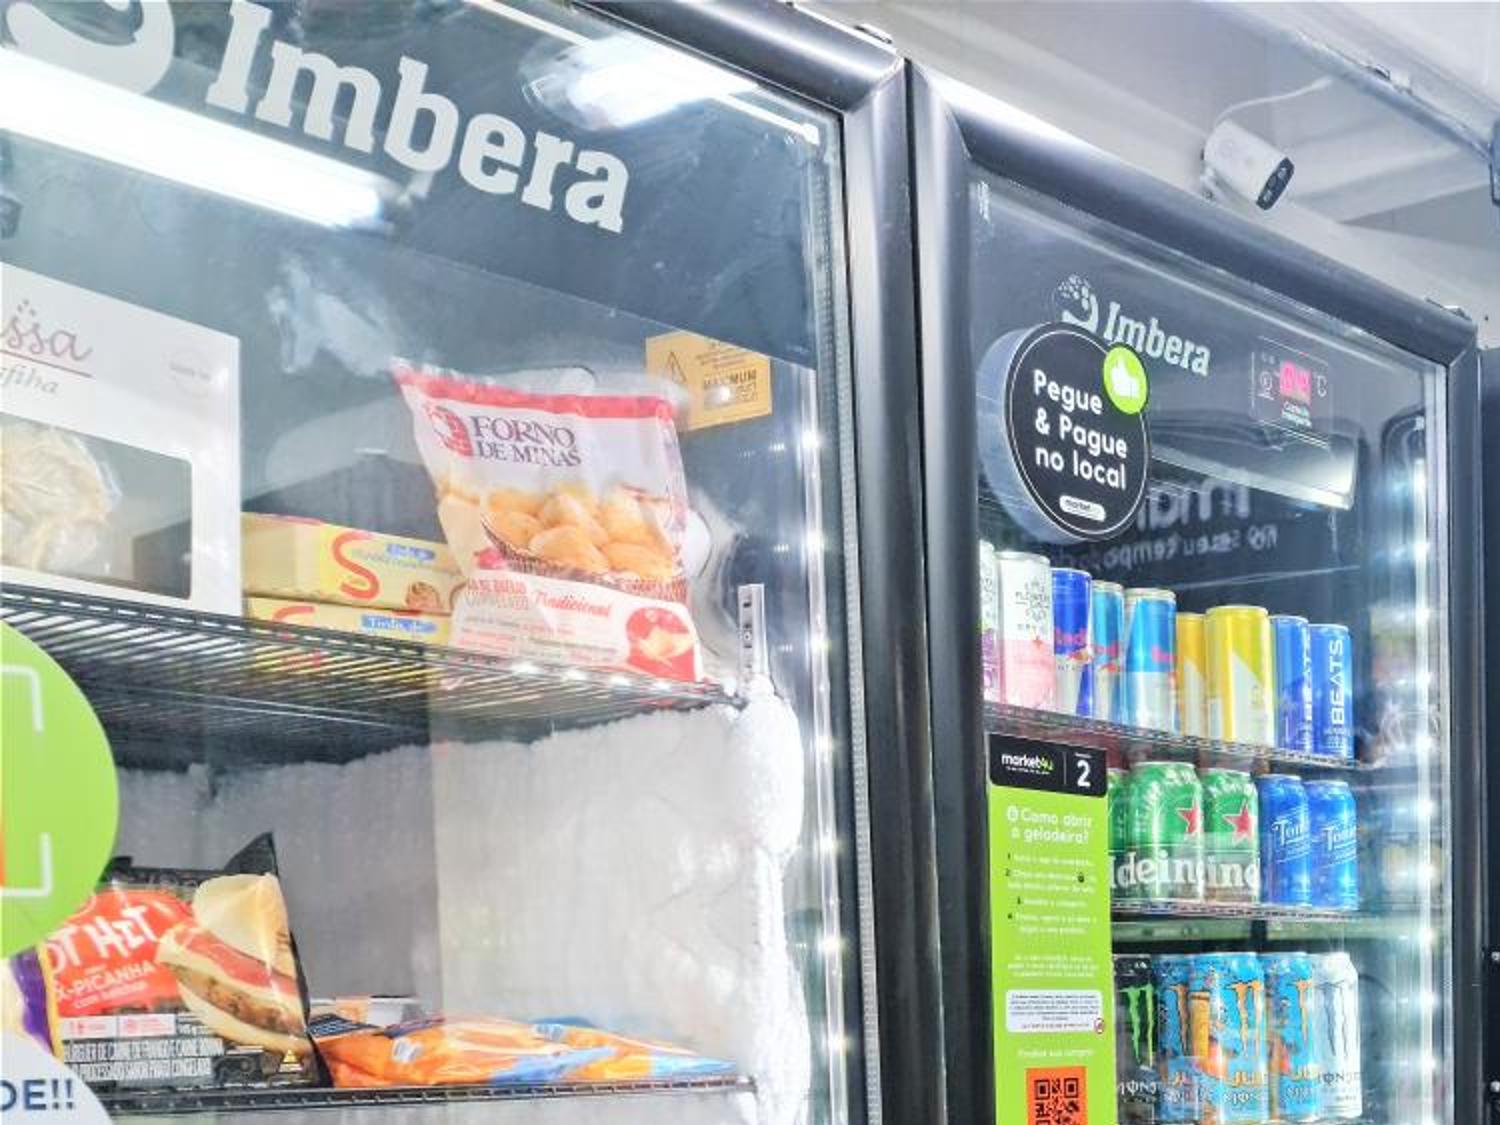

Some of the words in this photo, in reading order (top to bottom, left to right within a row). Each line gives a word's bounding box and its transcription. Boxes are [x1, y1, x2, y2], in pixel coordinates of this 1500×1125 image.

[206, 2, 629, 232] Imbera
[1102, 303, 1212, 377] Imbera
[1032, 369, 1104, 417] Pegue
[473, 415, 577, 449] FORNO
[476, 441, 511, 465] DE
[1034, 409, 1051, 437] &
[1058, 418, 1129, 461] Pague
[1034, 447, 1066, 475] no
[1072, 458, 1128, 491] local
[1076, 760, 1091, 789] 2
